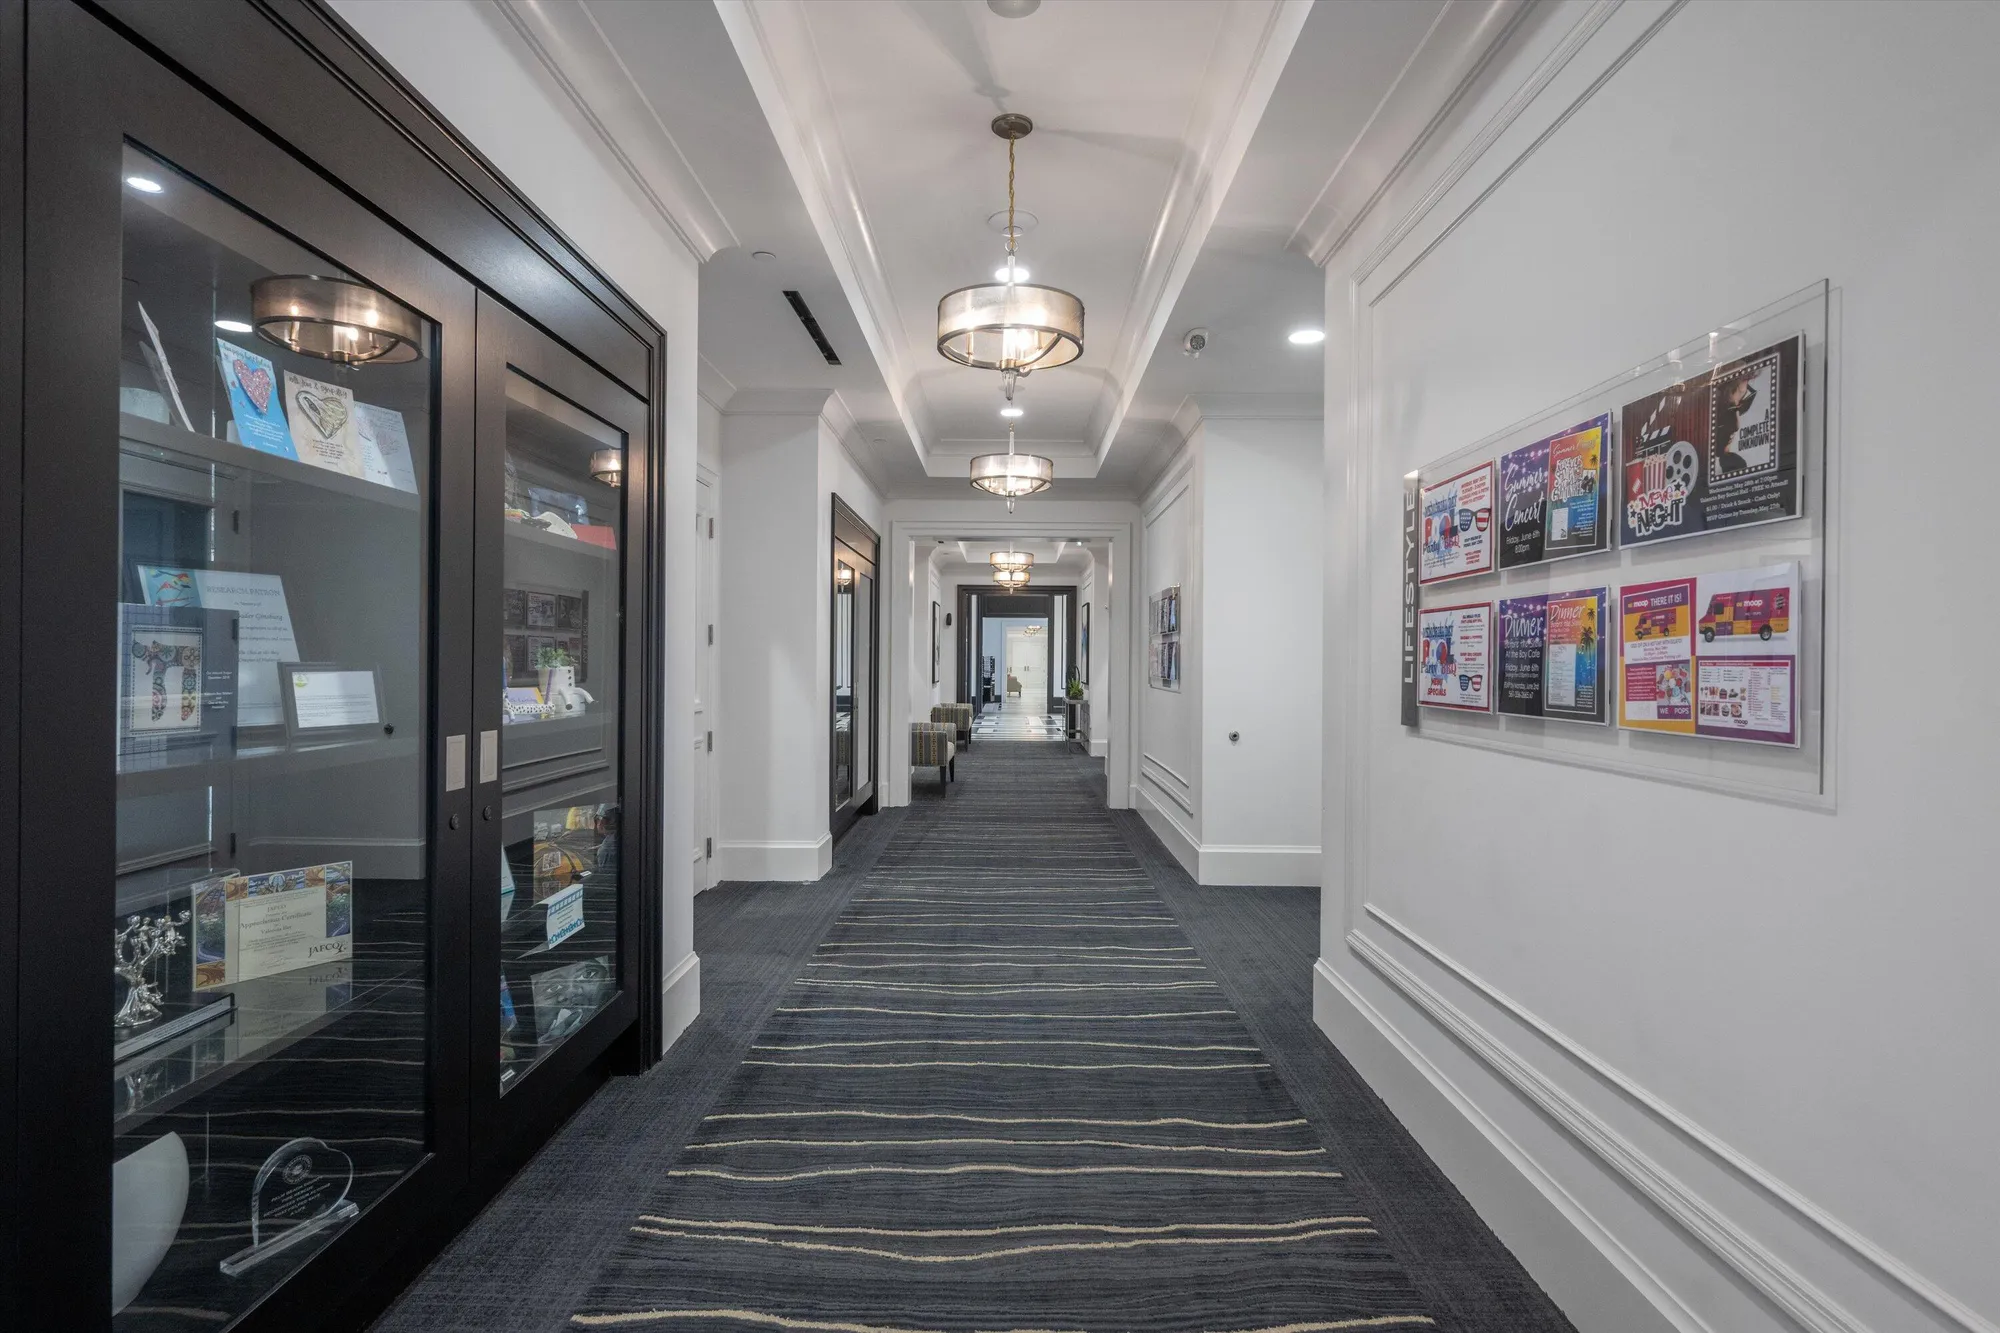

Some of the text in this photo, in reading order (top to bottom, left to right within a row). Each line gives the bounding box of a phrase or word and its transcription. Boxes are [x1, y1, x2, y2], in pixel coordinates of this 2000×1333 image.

[1764, 408, 1770, 420] A
[1739, 420, 1770, 440] COMPLETE
[1738, 432, 1770, 452] UNKNOWN
[1504, 462, 1544, 501] Summer
[1709, 486, 1733, 494] Wednesday,
[1505, 491, 1545, 532] Concert
[1636, 499, 1684, 536] NIGHT
[1520, 533, 1532, 542] June
[206, 586, 280, 596] RESEARCH PATRON
[1404, 487, 1416, 684] LIFESTYLE
[1633, 599, 1648, 608] moop
[1651, 595, 1667, 607] THERE
[1668, 595, 1674, 604] IT
[1744, 599, 1762, 607] moop
[1550, 605, 1585, 620] Dinner
[1502, 614, 1543, 637] Dinner
[1519, 650, 1527, 660] Bay
[1528, 649, 1540, 658] Cafe
[1421, 662, 1436, 674] Party
[1427, 688, 1446, 696] SPECIALS
[308, 942, 340, 958] JAFCO
